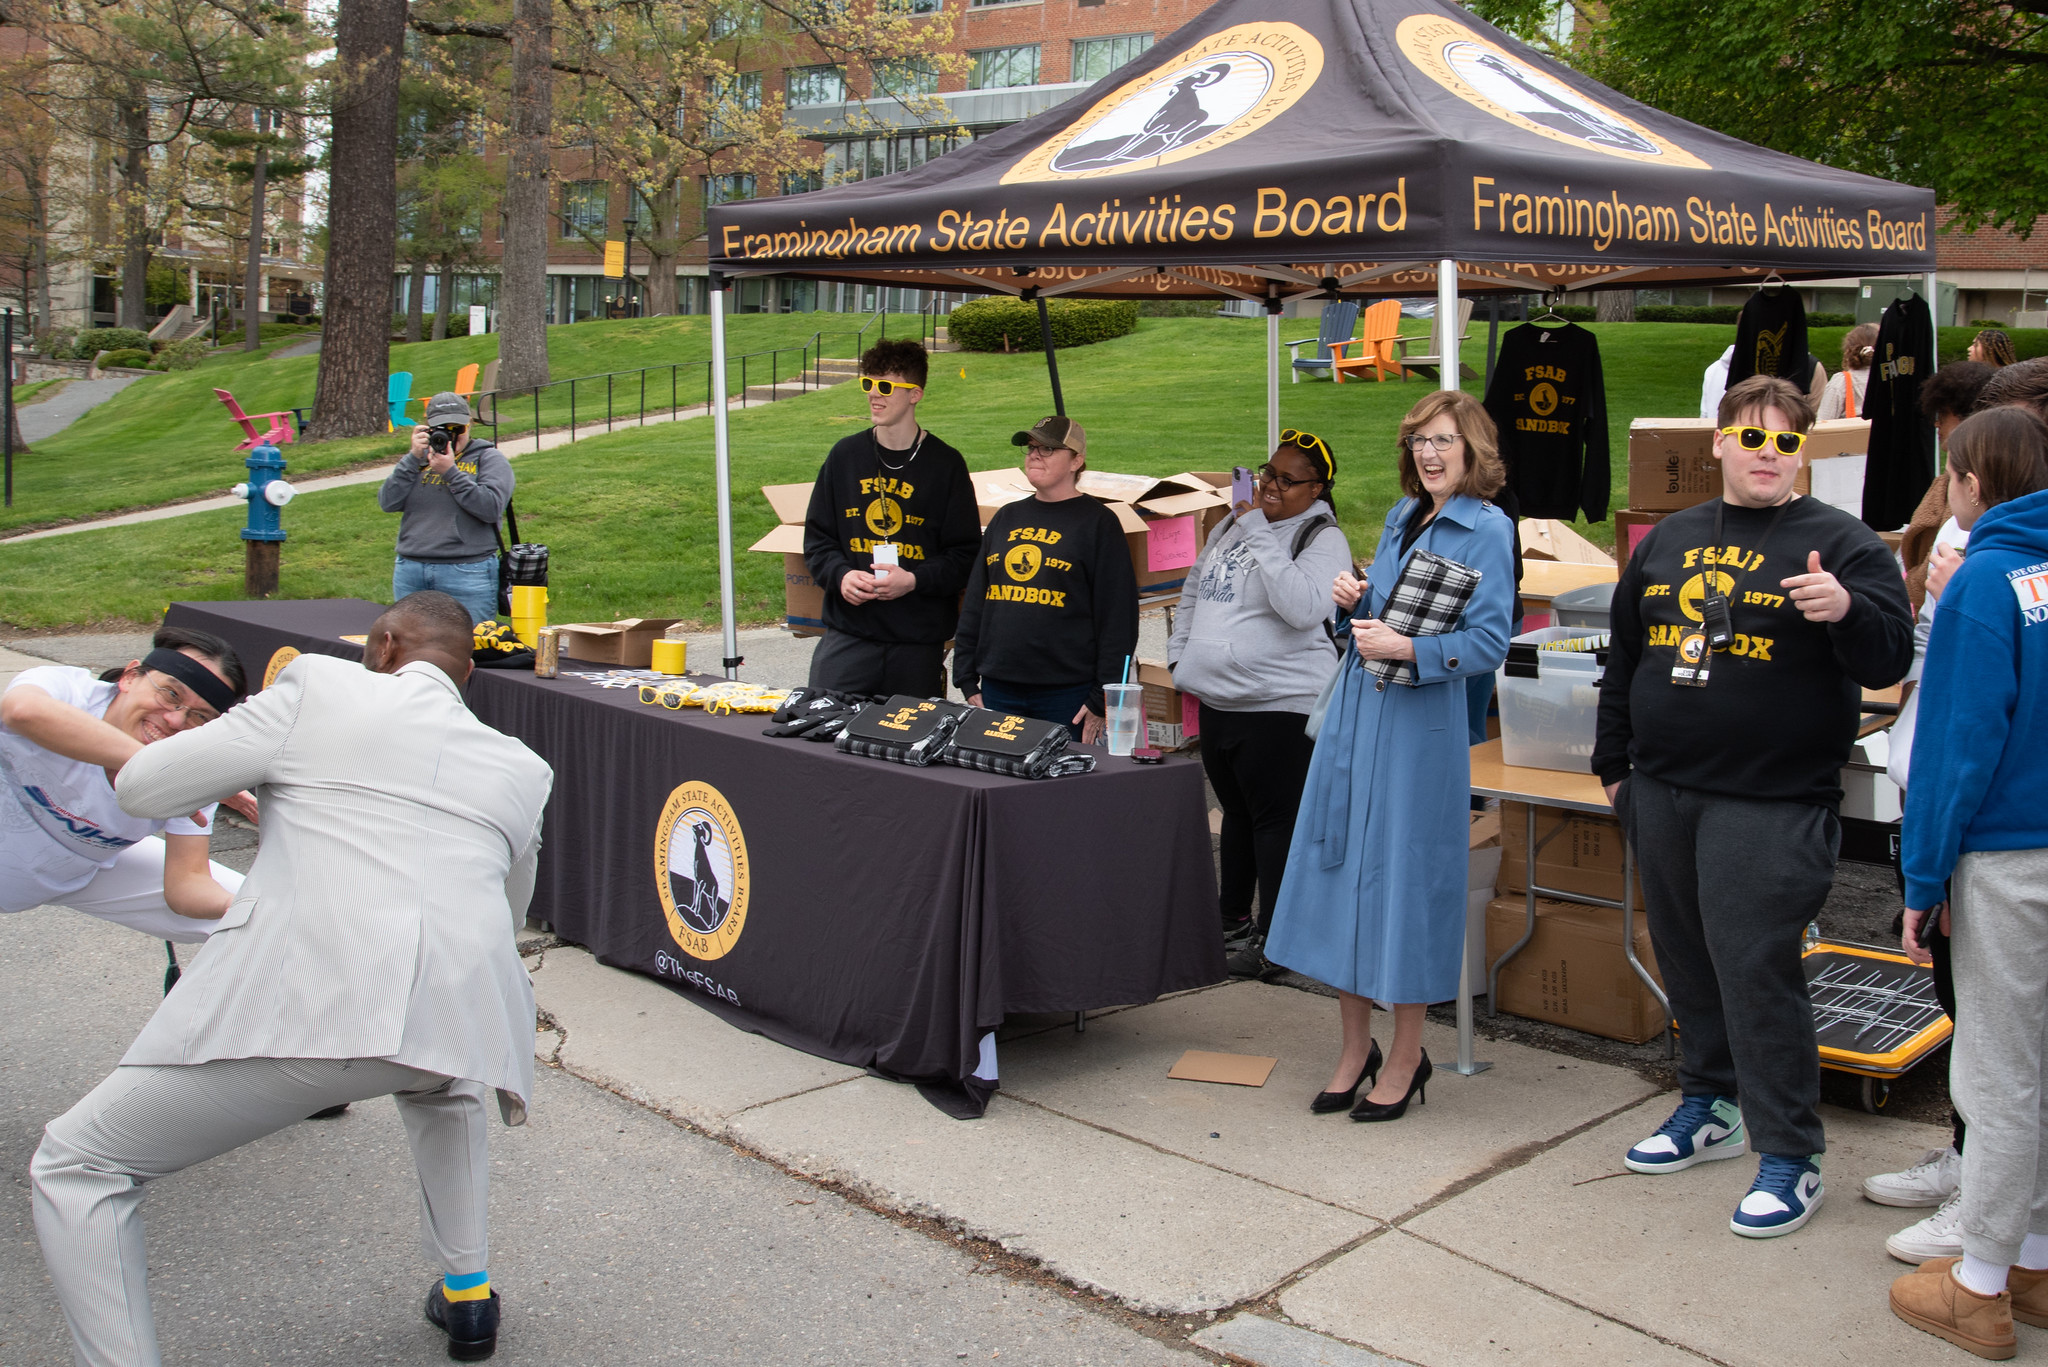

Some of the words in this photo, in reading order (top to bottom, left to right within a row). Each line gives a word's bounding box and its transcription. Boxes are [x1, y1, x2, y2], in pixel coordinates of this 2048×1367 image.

[1245, 31, 1307, 93] ACTIVITIES
[722, 217, 921, 260] Framingham
[930, 207, 1031, 251] State
[1039, 194, 1237, 248] Activities
[1253, 177, 1408, 239] Board
[1473, 176, 1680, 251] Framingham
[1686, 196, 1758, 246] State
[1764, 202, 1864, 250] Activities
[1867, 209, 1926, 251] Board
[1525, 365, 1567, 382] FSAB
[860, 477, 914, 499] FSAB
[1007, 527, 1062, 545] FSAB
[850, 537, 925, 560] SANBOX
[1044, 557, 1073, 572] 1977
[2005, 567, 2029, 580] LIVE
[2026, 564, 2042, 574] ON
[986, 584, 1067, 608] ANDBOX
[1644, 584, 1671, 597] EST.
[1743, 591, 1785, 608] 1977
[2022, 605, 2048, 627] NO
[1649, 625, 1775, 661] SANOX
[681, 790, 709, 805] STATE
[659, 798, 681, 899] FRAMINGHAM
[711, 798, 745, 880] ACTIVITIES
[727, 887, 745, 937] BOARD
[678, 925, 709, 953] FSAB
[655, 949, 741, 1007] @TheFSAB
